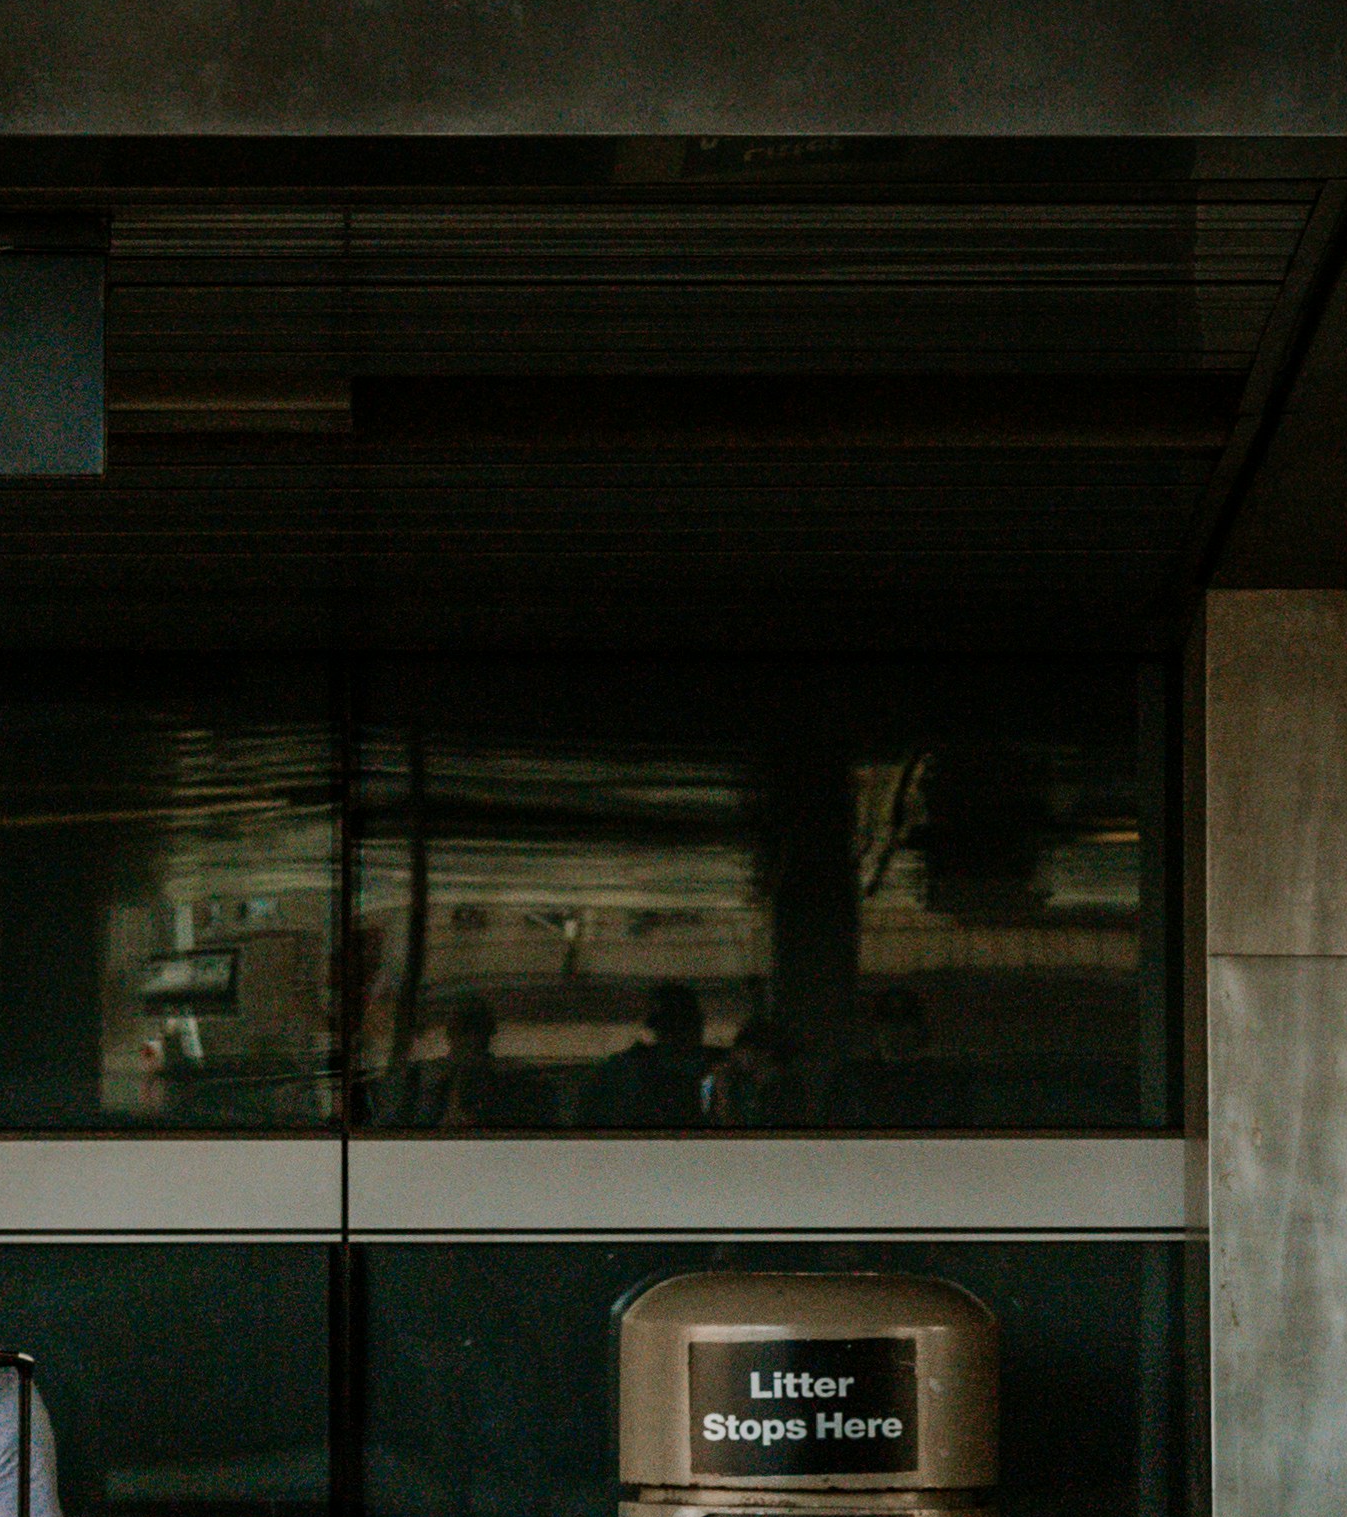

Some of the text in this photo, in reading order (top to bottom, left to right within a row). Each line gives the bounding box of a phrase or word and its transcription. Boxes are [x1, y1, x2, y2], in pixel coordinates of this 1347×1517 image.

[749, 1371, 855, 1399] Litter
[702, 1411, 903, 1446] Stops Here
